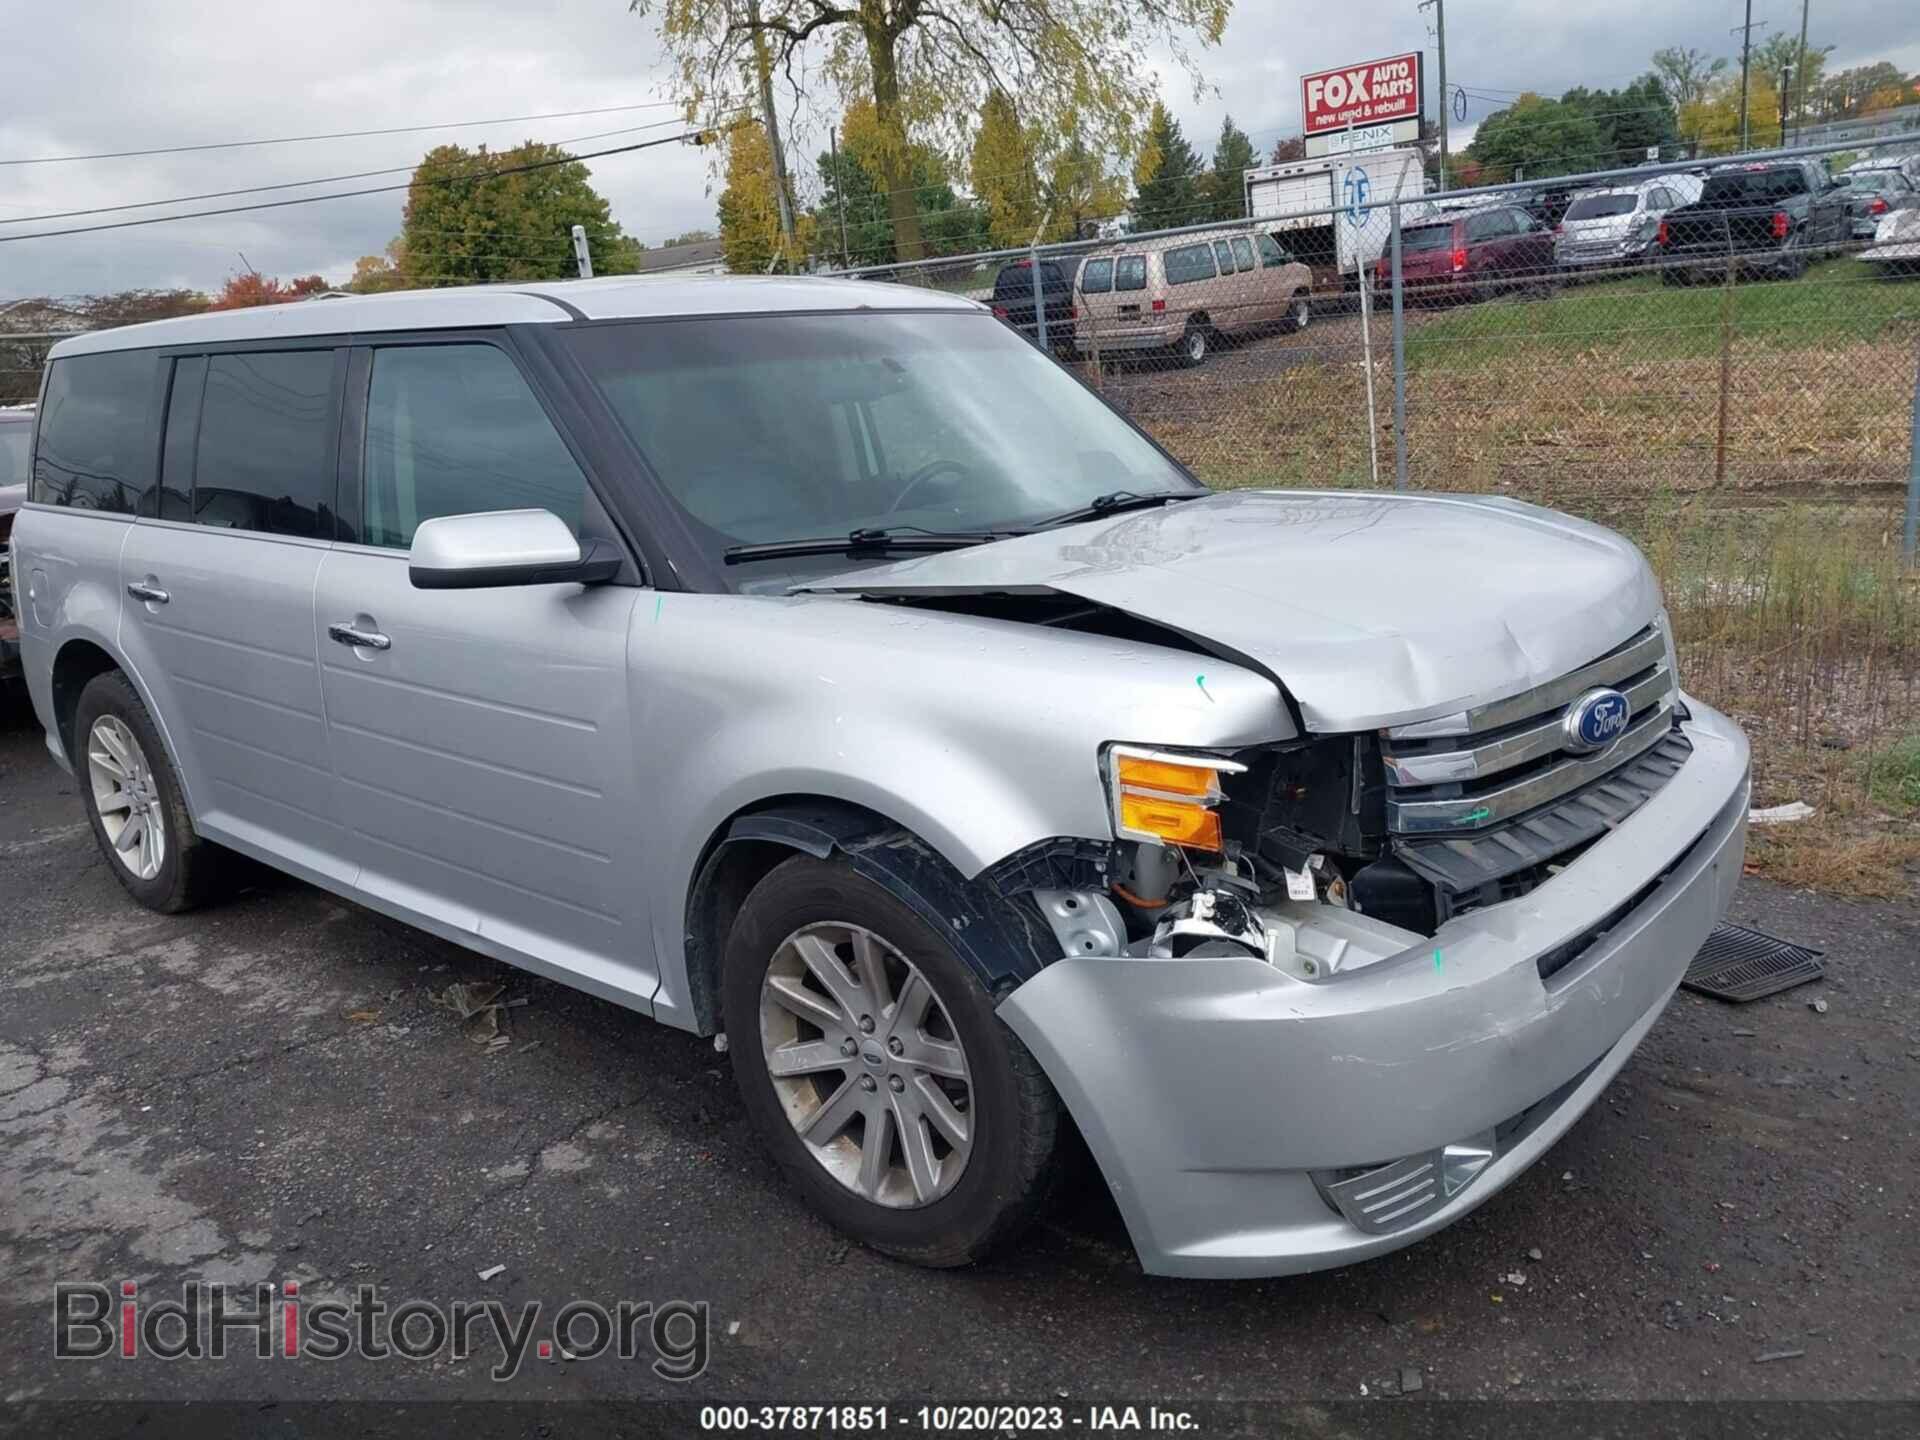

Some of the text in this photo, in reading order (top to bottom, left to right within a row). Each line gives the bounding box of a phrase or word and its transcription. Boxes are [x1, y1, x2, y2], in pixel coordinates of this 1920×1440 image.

[1373, 62, 1409, 83] AUTO
[1307, 70, 1370, 112] FOX
[1373, 78, 1413, 100] PARTS
[1315, 114, 1336, 126] new
[1364, 105, 1371, 117] &
[1374, 98, 1406, 115] rebuilt
[1593, 700, 1626, 737] Ford
